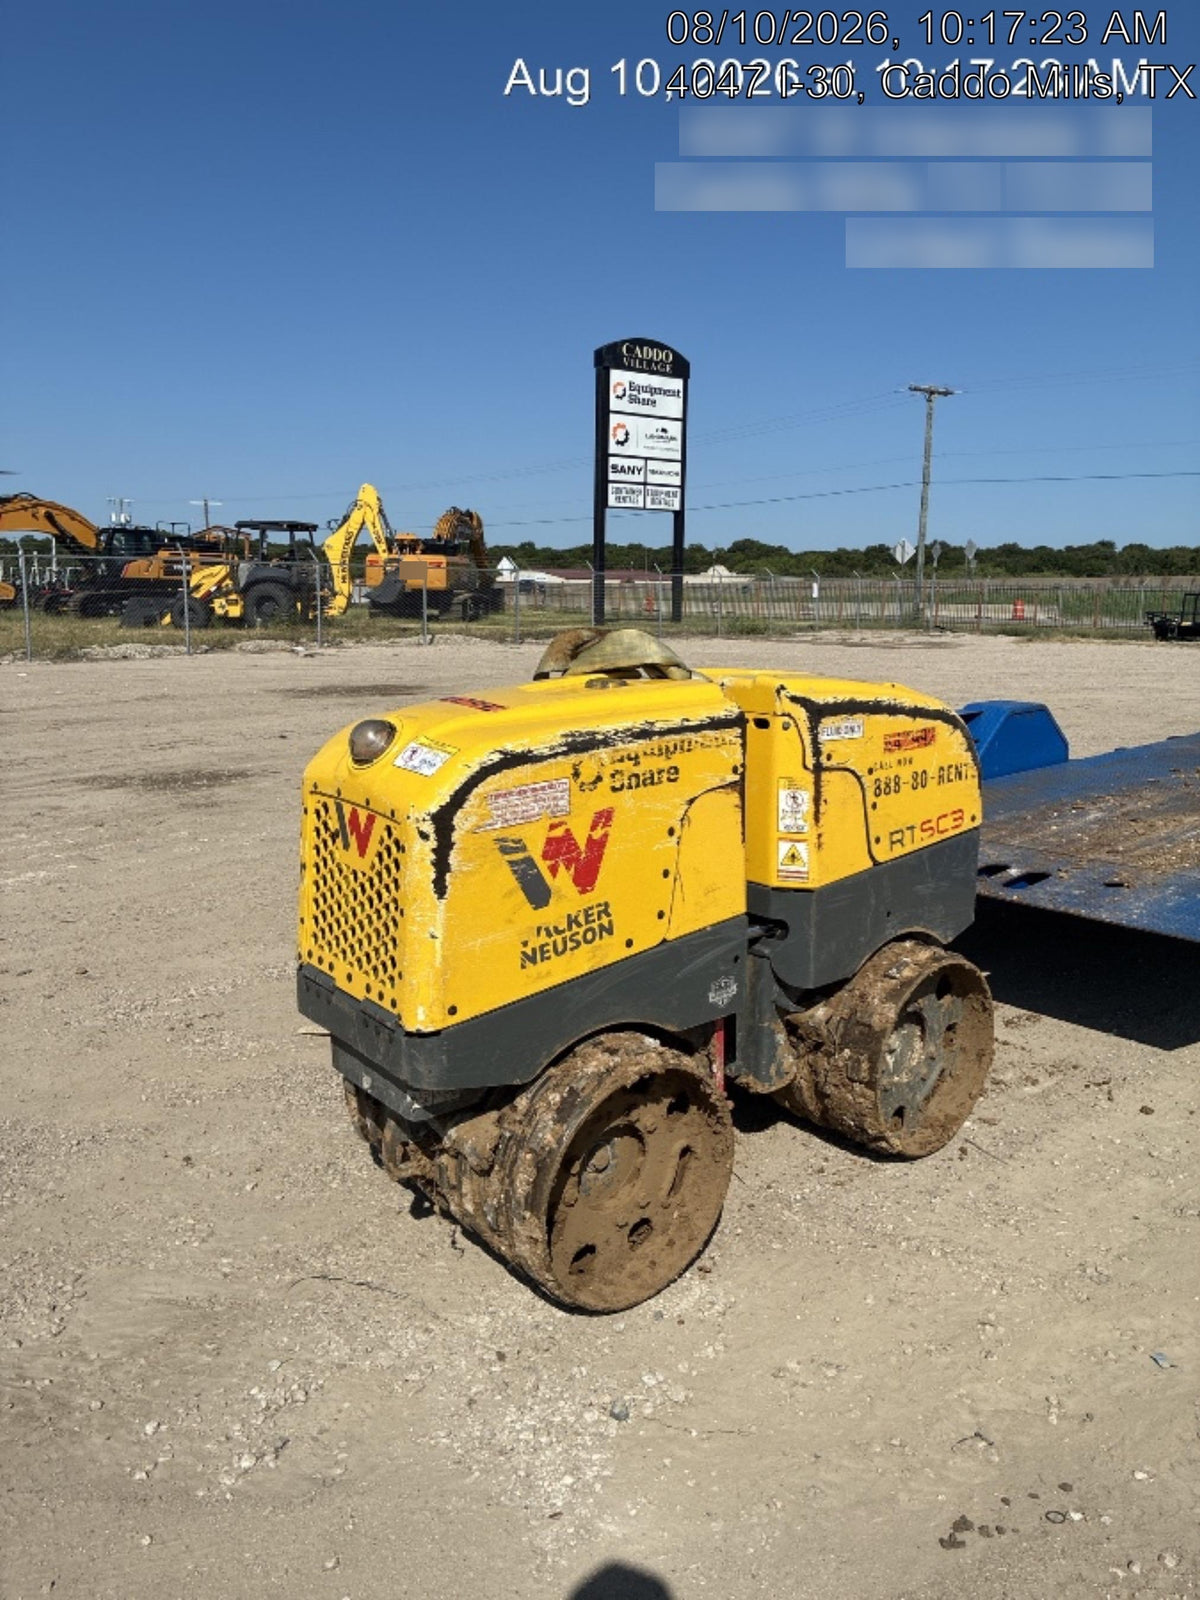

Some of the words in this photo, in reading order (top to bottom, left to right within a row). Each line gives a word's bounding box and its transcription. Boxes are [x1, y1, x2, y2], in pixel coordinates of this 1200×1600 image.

[622, 342, 673, 364] CADDO
[623, 357, 673, 373] VILLAGE
[628, 381, 682, 398] Equipment
[627, 393, 657, 407] Share
[610, 463, 643, 475] SANY
[520, 919, 615, 970] NEUSON
